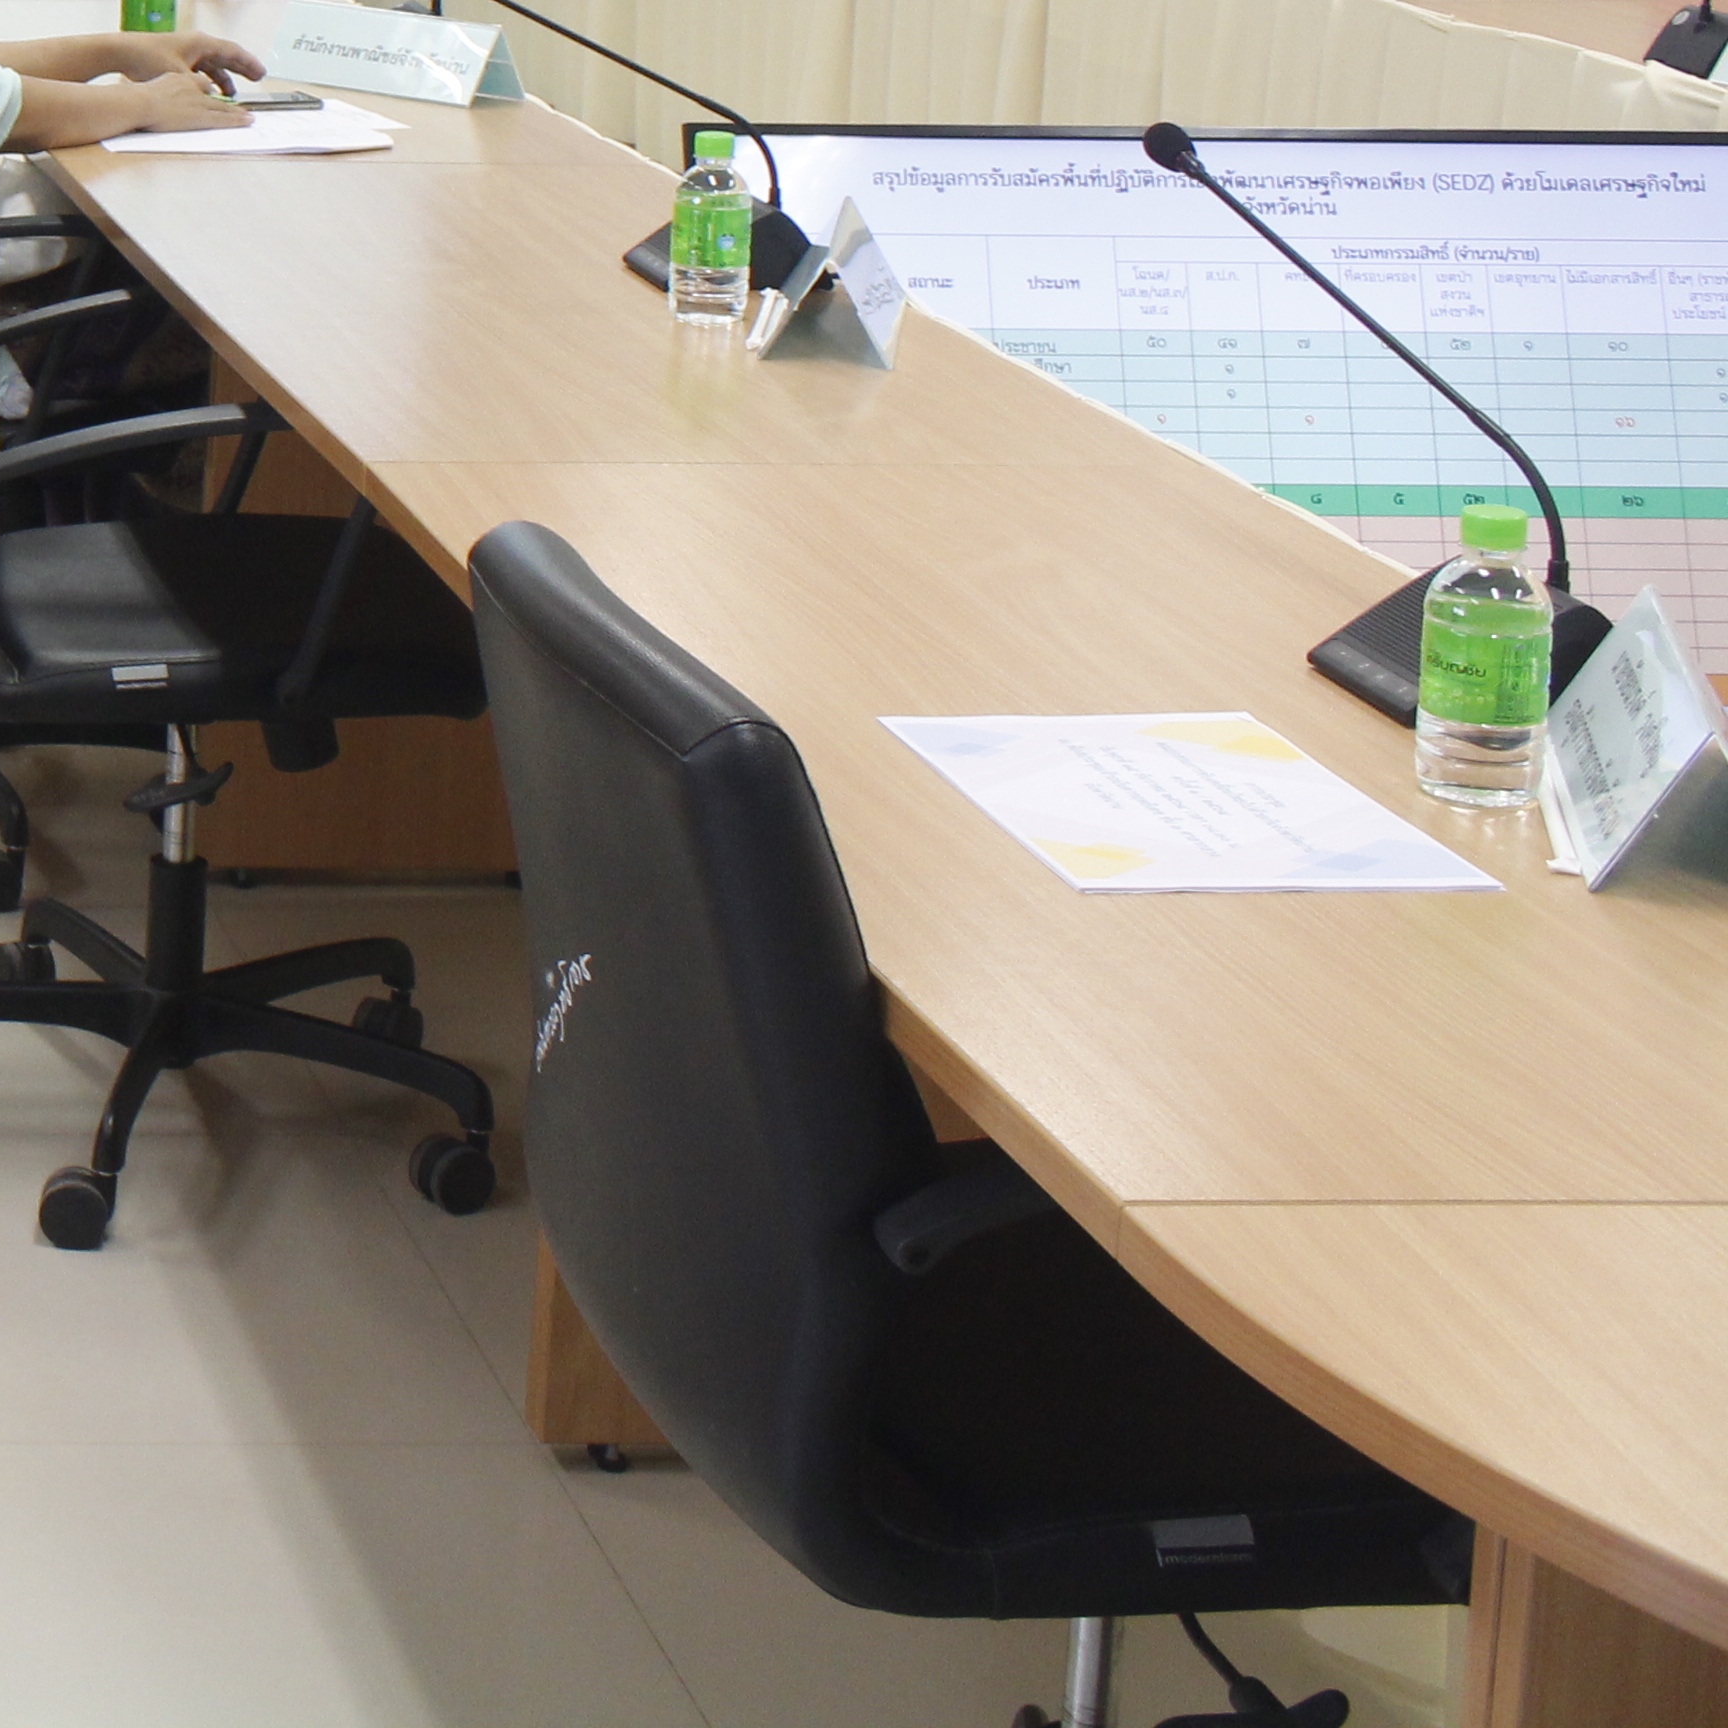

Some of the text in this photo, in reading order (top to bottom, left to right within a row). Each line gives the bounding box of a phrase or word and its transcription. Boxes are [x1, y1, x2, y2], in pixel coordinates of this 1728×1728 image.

[291, 33, 470, 75] สำนักงานพาณิชย์จังหัดน่าน
[872, 163, 1706, 198] สรุปข้อมูลการรับสมัครพื้นที่ปฏิบัติการเพัฒนาเศรษฐกิจพอเพียง (SEDZ) ด้วยโมเดลเศรษฐกิจใหม่
[1454, 245, 1540, 262] (จำนวน/ราย)
[908, 276, 1080, 291] สถานะ ประเภท
